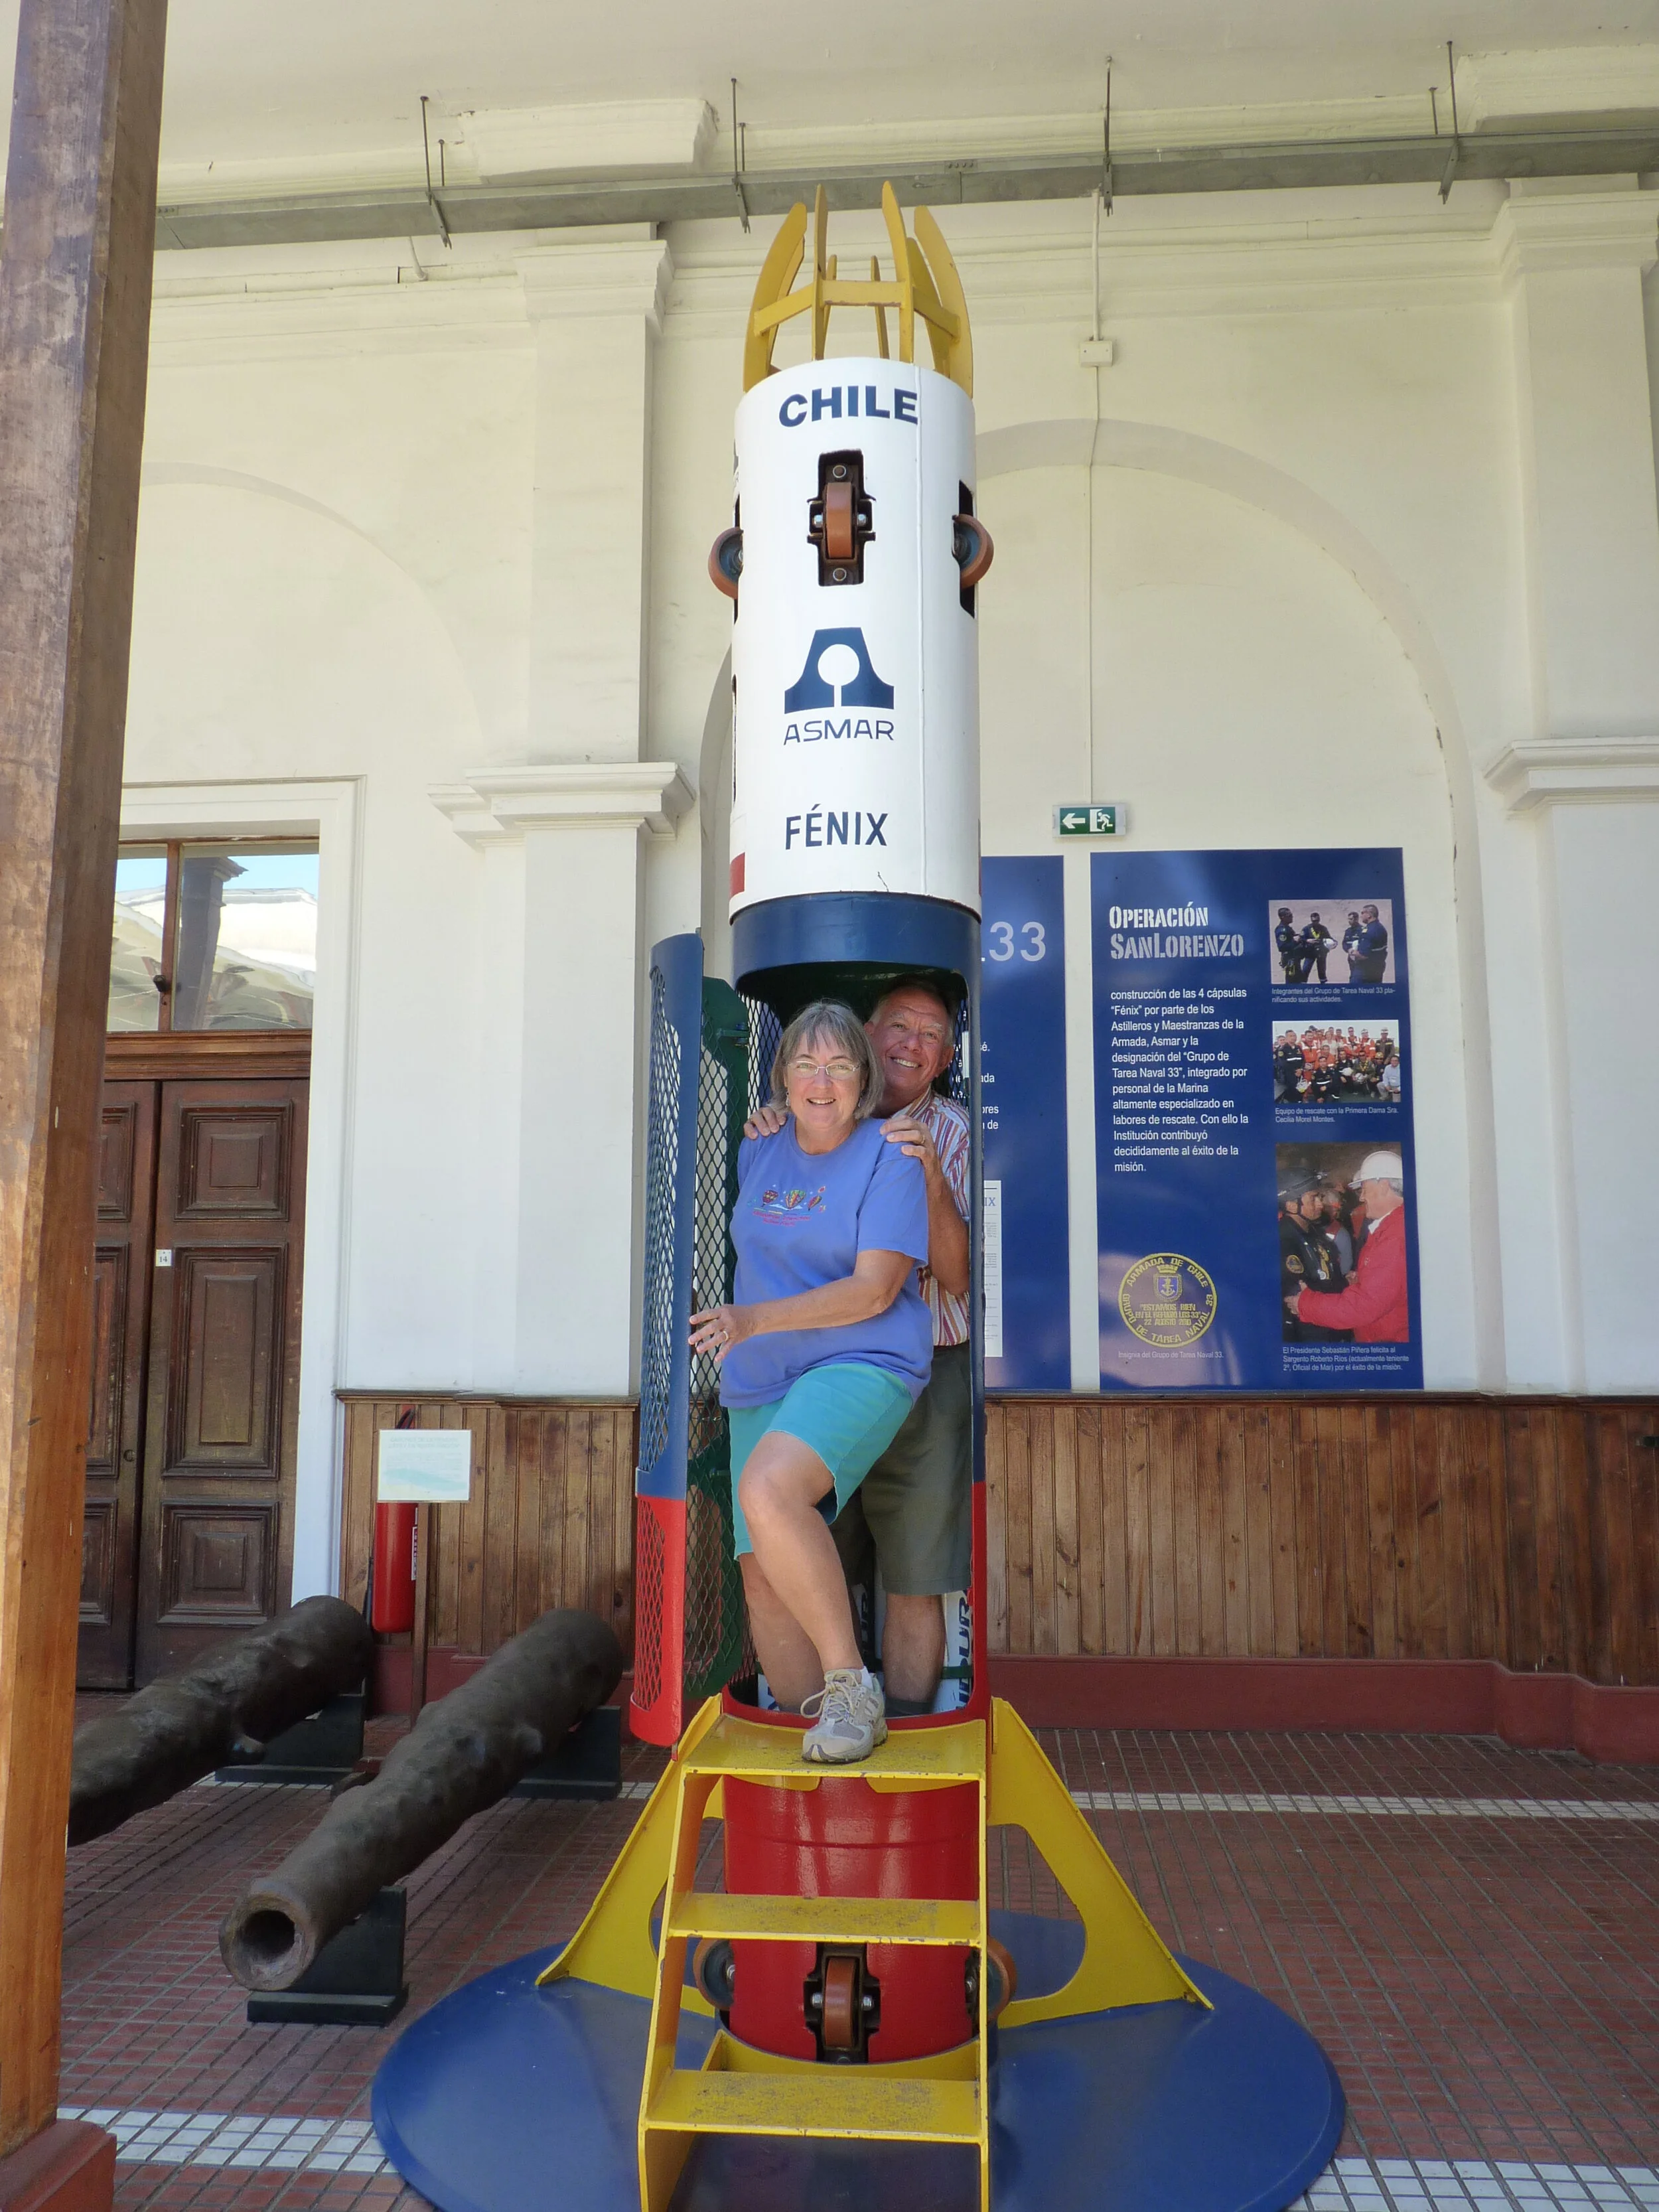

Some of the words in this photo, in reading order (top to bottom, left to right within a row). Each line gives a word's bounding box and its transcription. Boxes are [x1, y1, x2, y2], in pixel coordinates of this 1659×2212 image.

[779, 384, 918, 427] CHILE
[783, 718, 895, 746] ASMAR
[785, 804, 888, 850] FÉNIX
[1111, 990, 1166, 999] construcción
[1169, 989, 1180, 998] de
[1183, 989, 1196, 998] las
[1198, 989, 1204, 997] 4
[1207, 988, 1246, 999] cápsulas
[1315, 988, 1331, 996] Grupo
[1145, 1007, 1159, 1017] por
[1162, 1005, 1185, 1017] parte
[1187, 1004, 1198, 1013] de
[1201, 1003, 1214, 1013] los
[1112, 1021, 1151, 1031] Astilleros
[1154, 1023, 1159, 1032] y
[1162, 1020, 1219, 1030] Maestranzas
[1222, 1019, 1233, 1029] de
[1236, 1019, 1244, 1029] la
[1112, 1037, 1149, 1047] Armada,
[1151, 1037, 1181, 1046] Asmar
[1183, 1039, 1188, 1048] y
[1190, 1035, 1198, 1045] la
[1112, 1053, 1165, 1065] designación
[1167, 1052, 1181, 1061] del
[1218, 1051, 1229, 1061] de
[1112, 1068, 1137, 1078] Tarea
[1140, 1067, 1165, 1077] Naval
[1188, 1067, 1230, 1079] integrado
[1233, 1069, 1248, 1078] por
[1113, 1083, 1151, 1095] personal
[1153, 1083, 1165, 1093] de
[1167, 1084, 1175, 1092] la
[1178, 1083, 1208, 1092] Marina
[1113, 1099, 1157, 1108] altamente
[1159, 1099, 1220, 1110] especializado
[987, 1120, 998, 1129] de
[1114, 1115, 1146, 1125] labores
[1149, 1114, 1160, 1124] de
[1163, 1115, 1198, 1124] rescate.
[1200, 1114, 1219, 1124] Con
[1222, 1114, 1238, 1123] ello
[1240, 1114, 1248, 1123] la
[1114, 1130, 1159, 1140] Institución
[1161, 1130, 1207, 1142] contribuyó
[1114, 1145, 1179, 1155] decididamente
[1182, 1145, 1189, 1155] al
[1192, 1145, 1214, 1155] éxito
[1216, 1145, 1228, 1155] de
[1231, 1145, 1238, 1155] la
[1115, 1161, 1145, 1171] misión.
[1127, 1258, 1165, 1287] ARMADA
[1171, 1258, 1184, 1266] DE
[1187, 1265, 1209, 1288] CHILE
[1186, 1311, 1210, 1337] NAVAL
